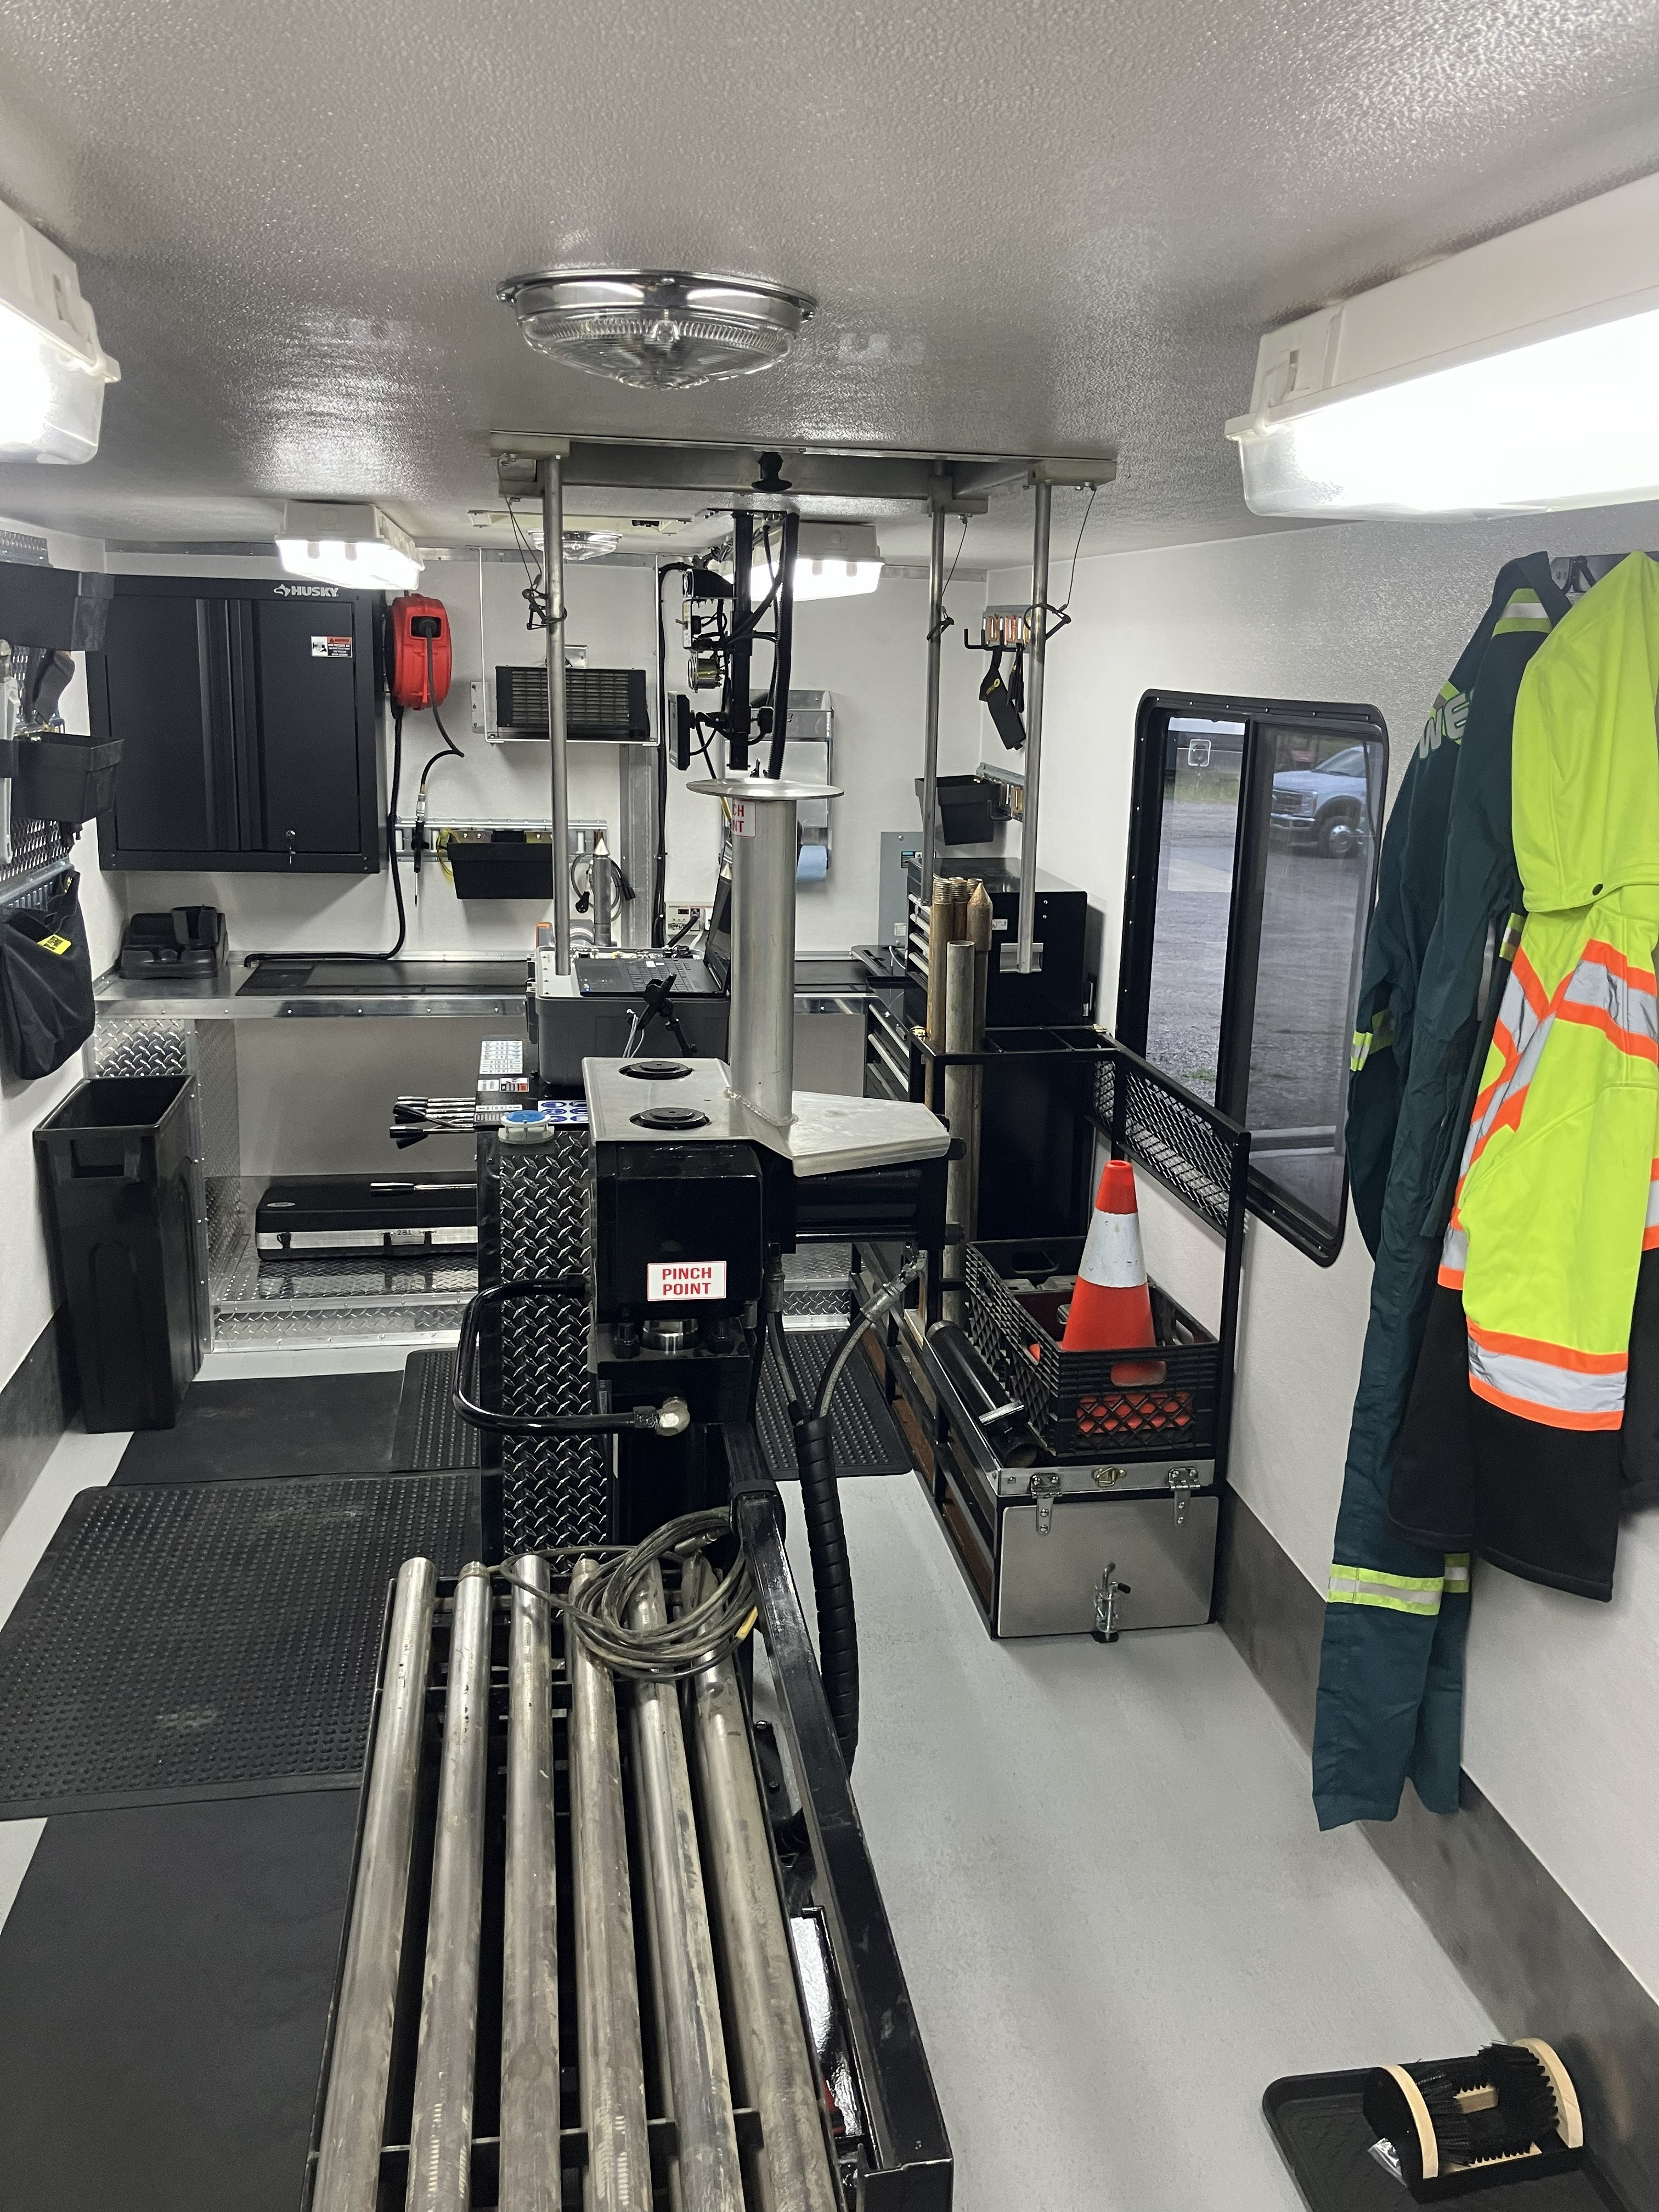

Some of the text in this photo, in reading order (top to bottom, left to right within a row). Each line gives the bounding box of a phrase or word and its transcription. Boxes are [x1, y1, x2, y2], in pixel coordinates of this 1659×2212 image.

[291, 585, 339, 597] HUSKY
[1419, 688, 1475, 759] WE
[662, 1267, 712, 1280] PINCH
[663, 1283, 712, 1296] POINT
